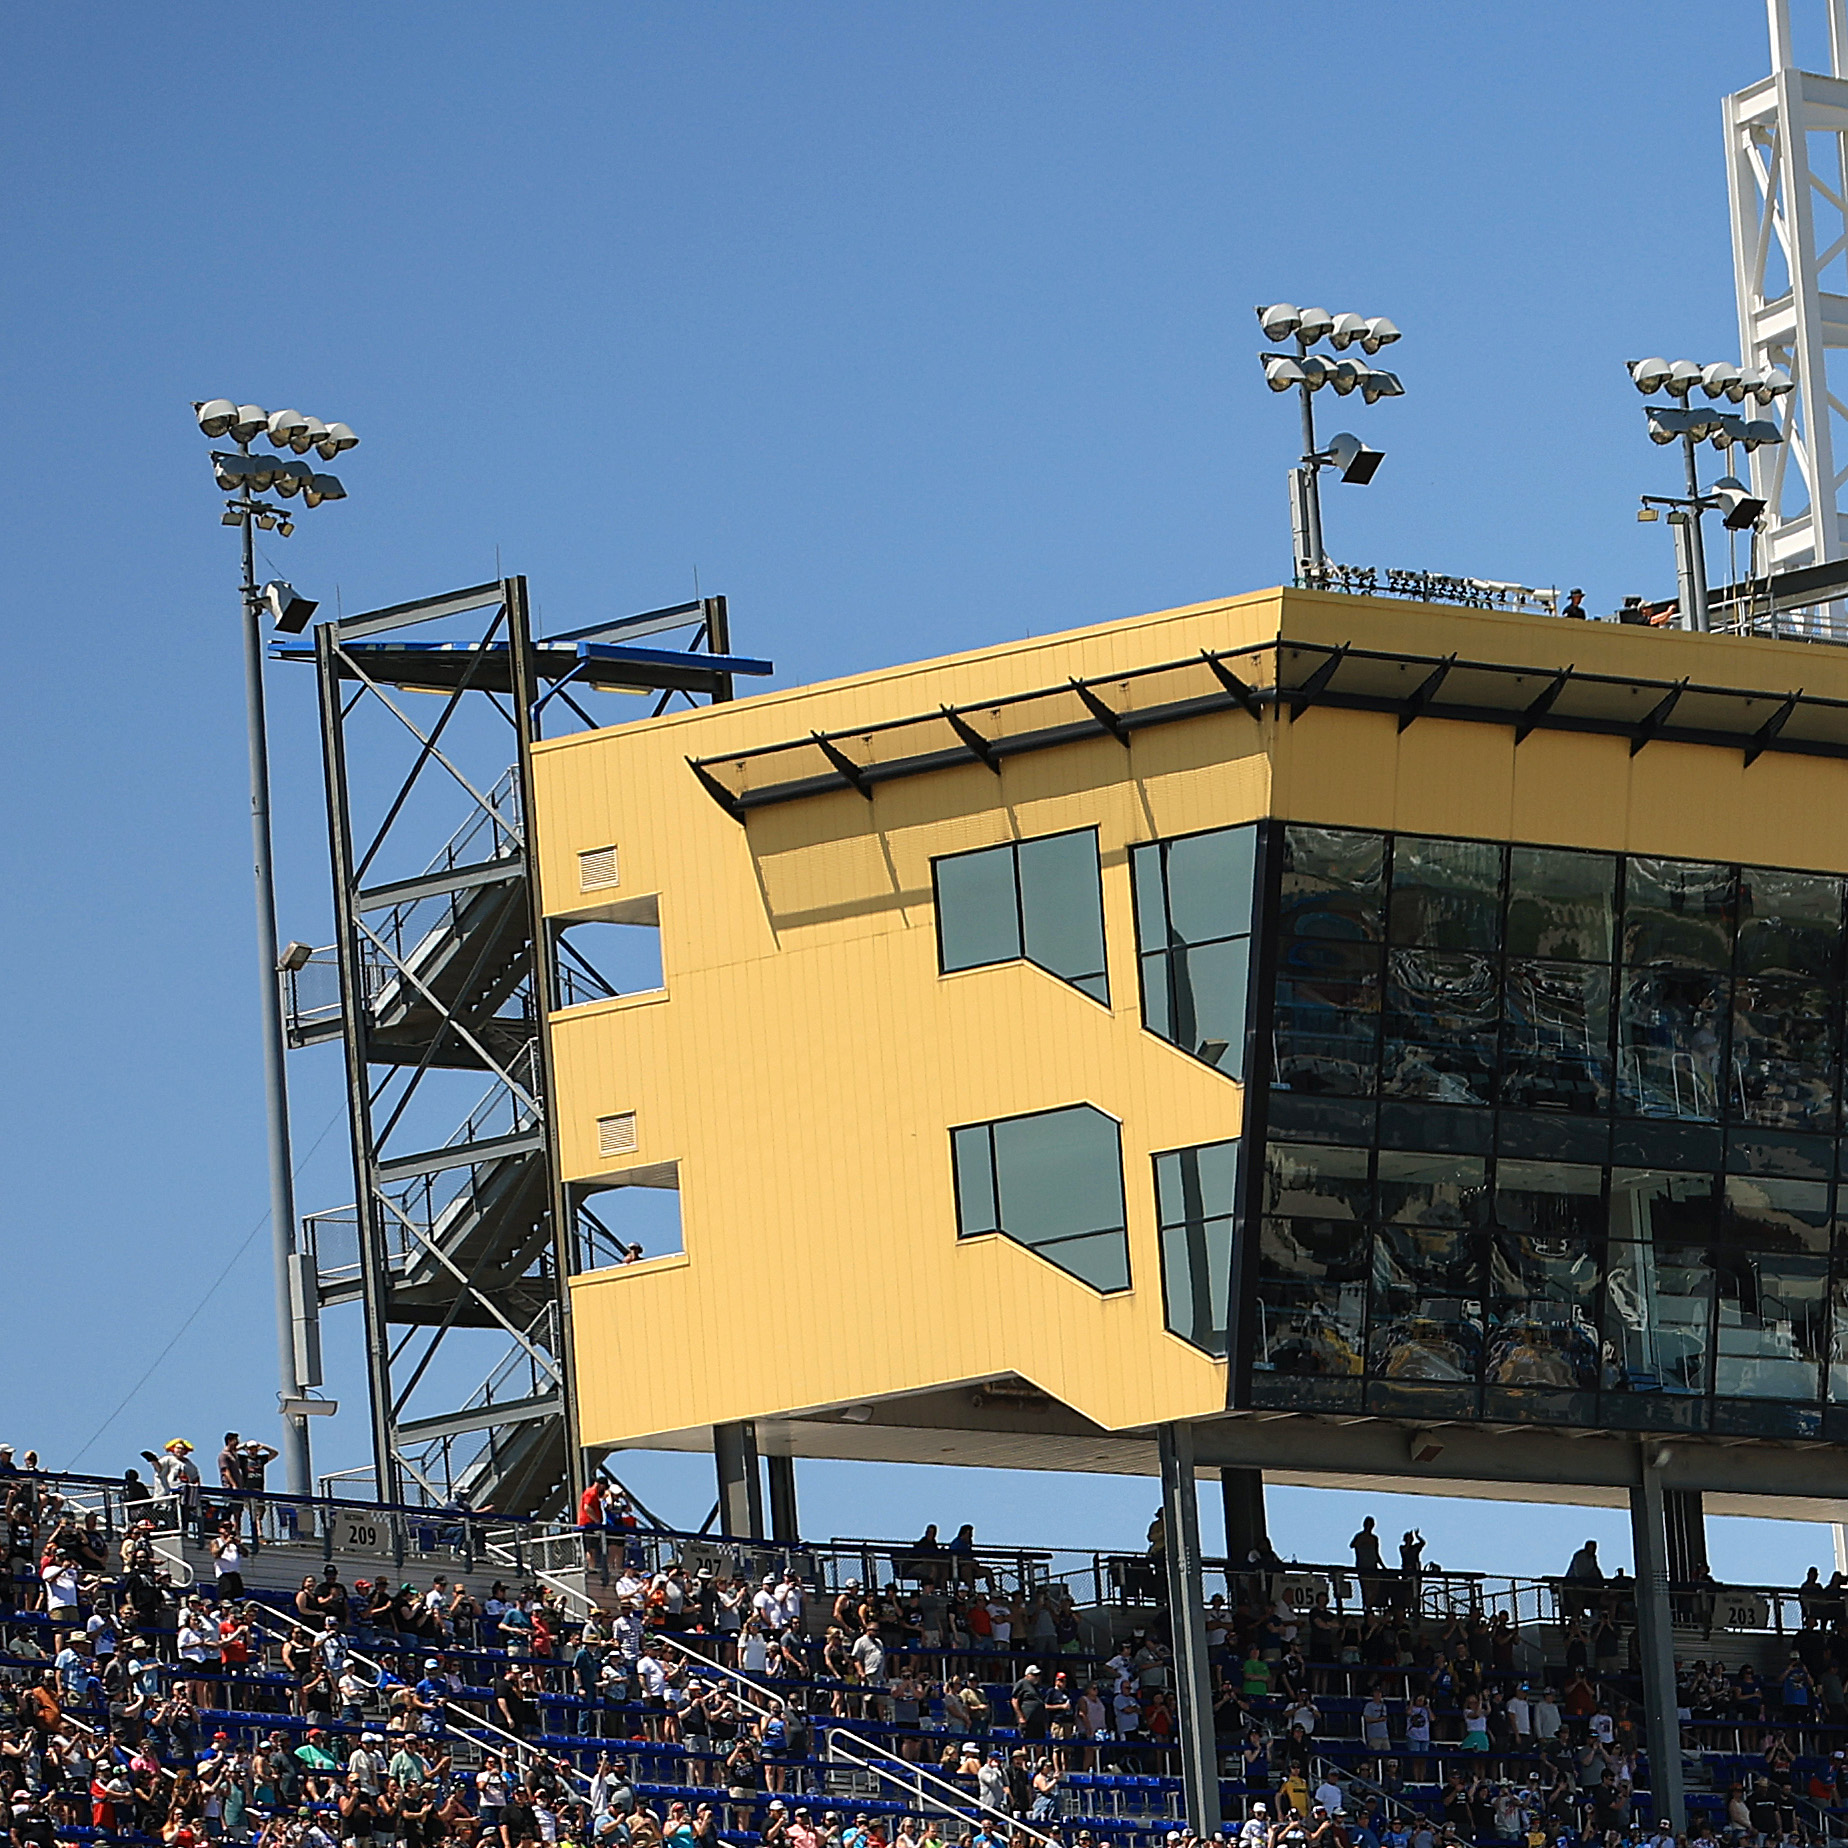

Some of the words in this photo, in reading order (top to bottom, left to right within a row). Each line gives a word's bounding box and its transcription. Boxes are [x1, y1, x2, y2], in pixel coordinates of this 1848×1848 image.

[348, 1525, 376, 1546] 209
[1293, 1586, 1314, 1606] 05
[1729, 1607, 1756, 1626] 203
